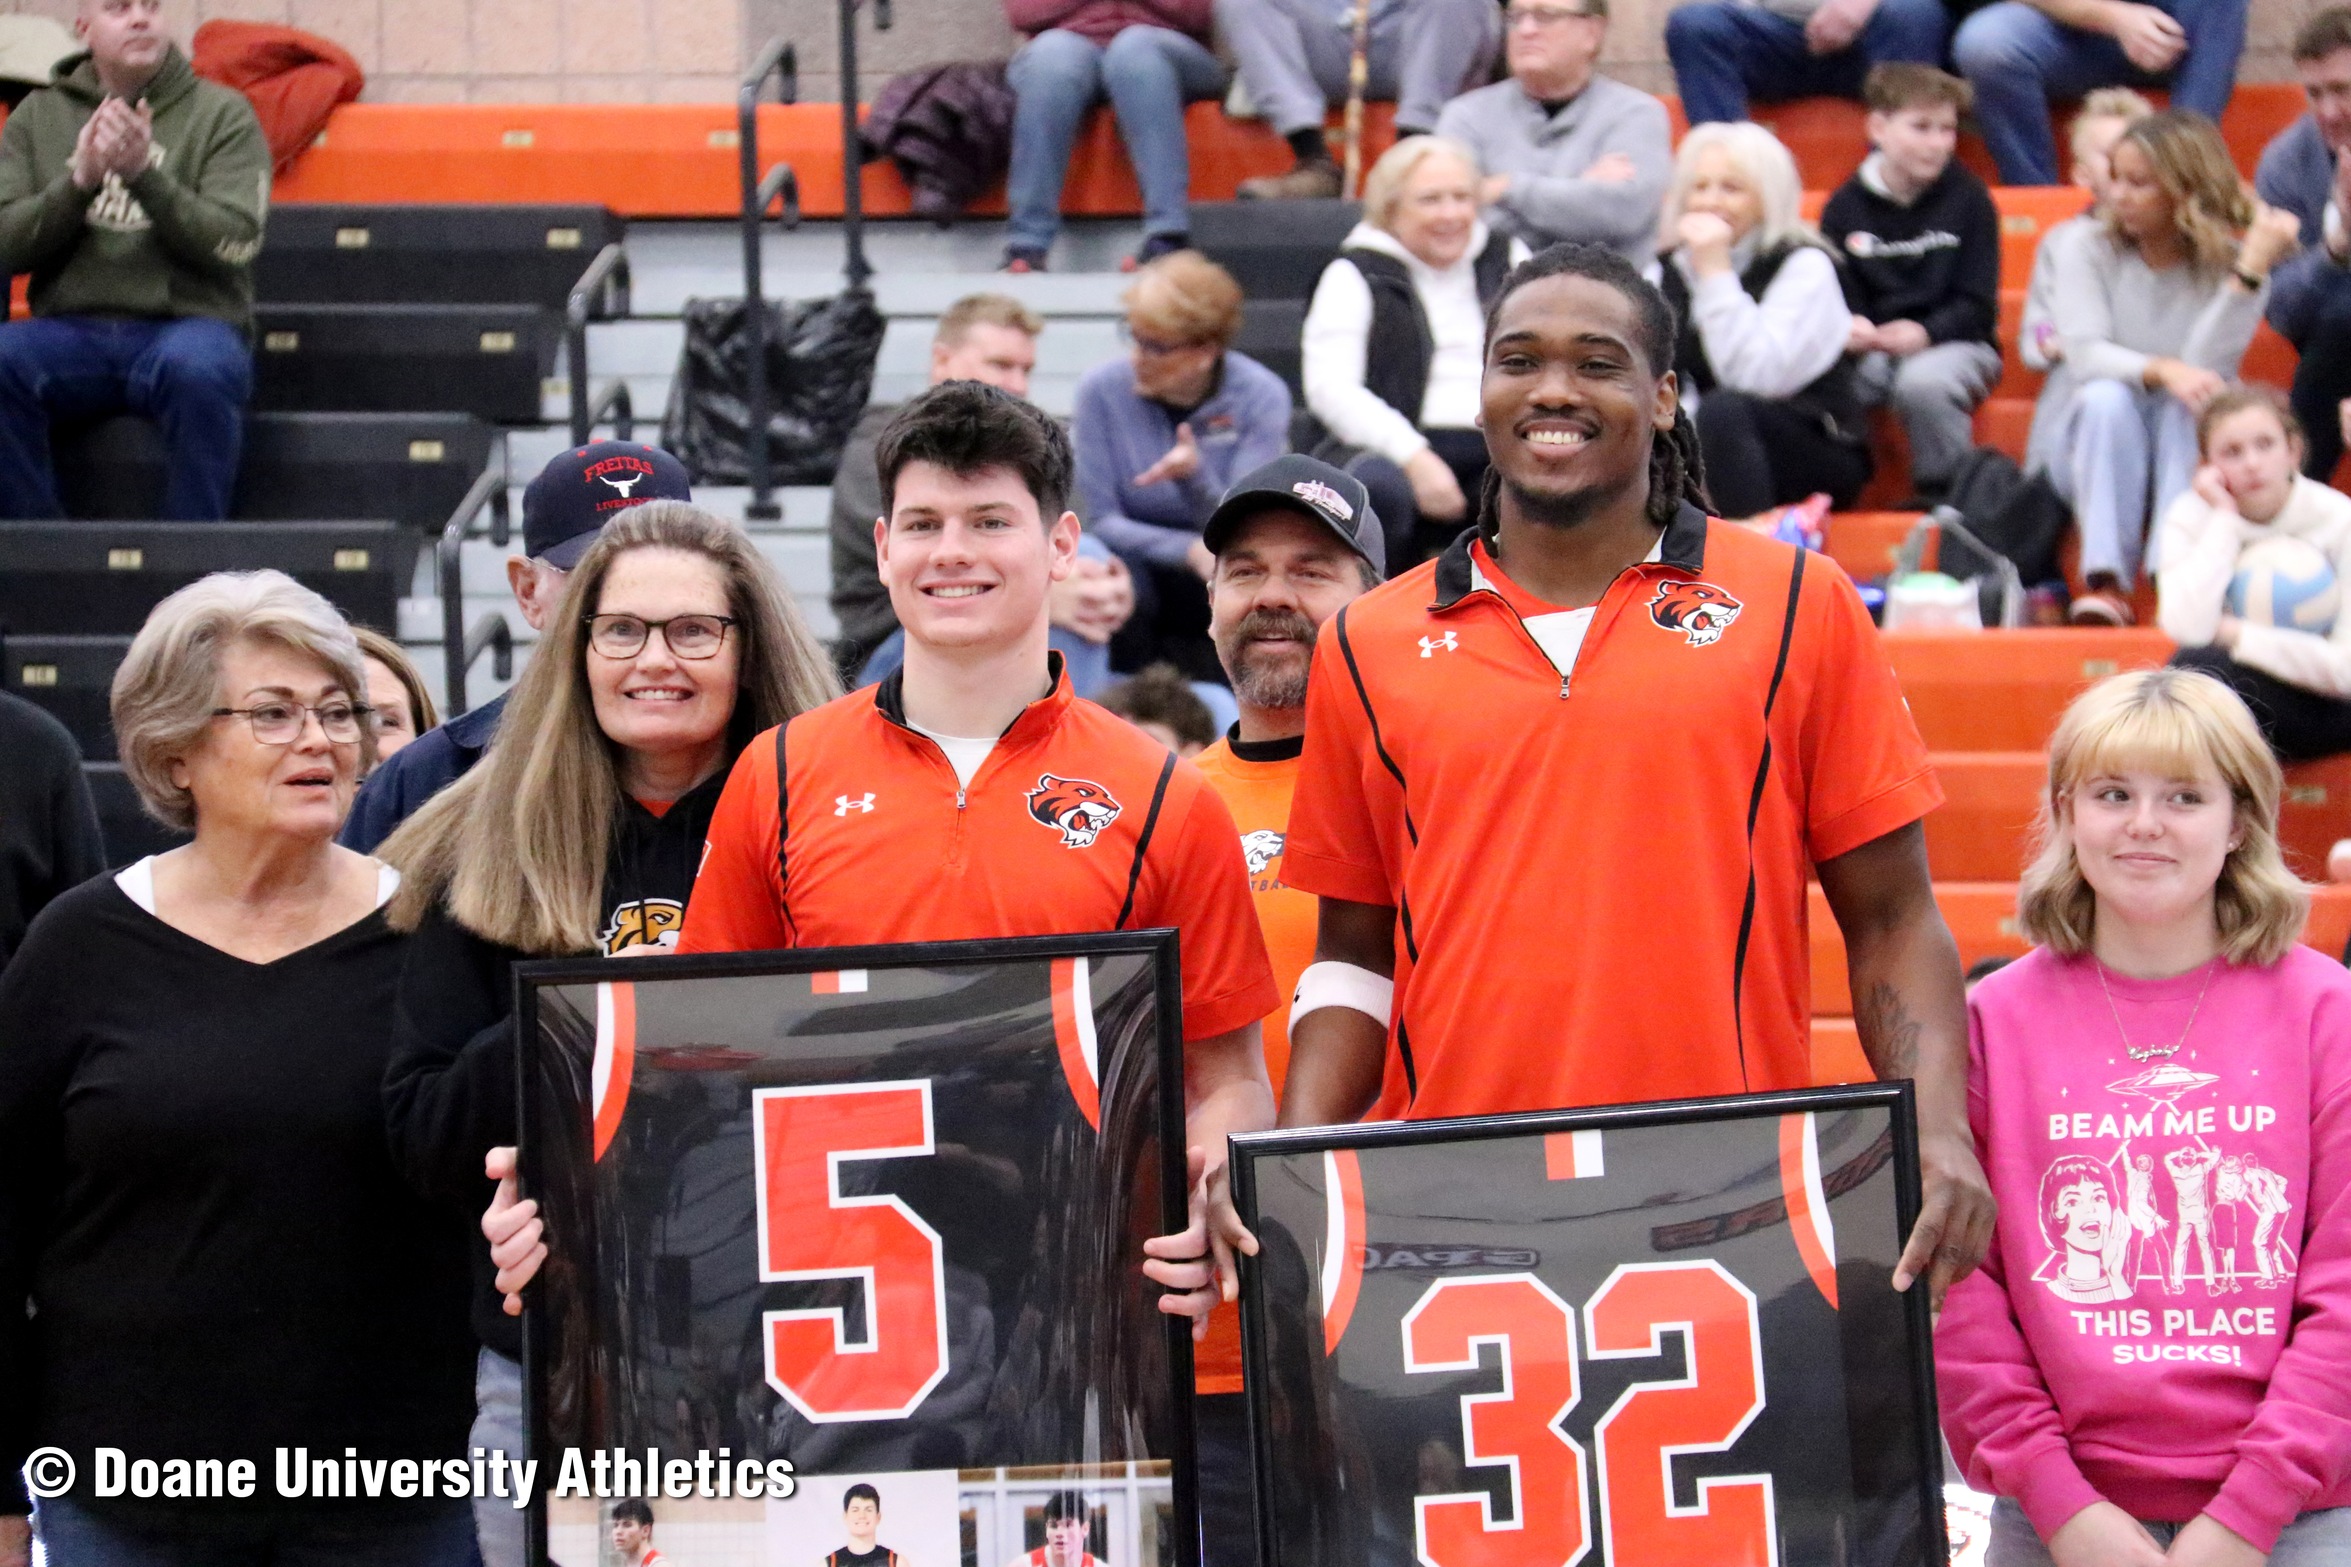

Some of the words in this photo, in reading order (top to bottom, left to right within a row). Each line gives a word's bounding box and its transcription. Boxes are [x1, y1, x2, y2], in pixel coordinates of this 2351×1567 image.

[584, 456, 654, 482] FREITAS
[2049, 1111, 2153, 1140] BEAM
[2164, 1107, 2216, 1136] ME
[2228, 1105, 2277, 1132] UP
[752, 1078, 949, 1424] 5
[2070, 1309, 2152, 1337] THIS
[2163, 1307, 2277, 1337] PLACE
[2112, 1344, 2242, 1367] SUCKS!
[1401, 1258, 1779, 1567] 32
